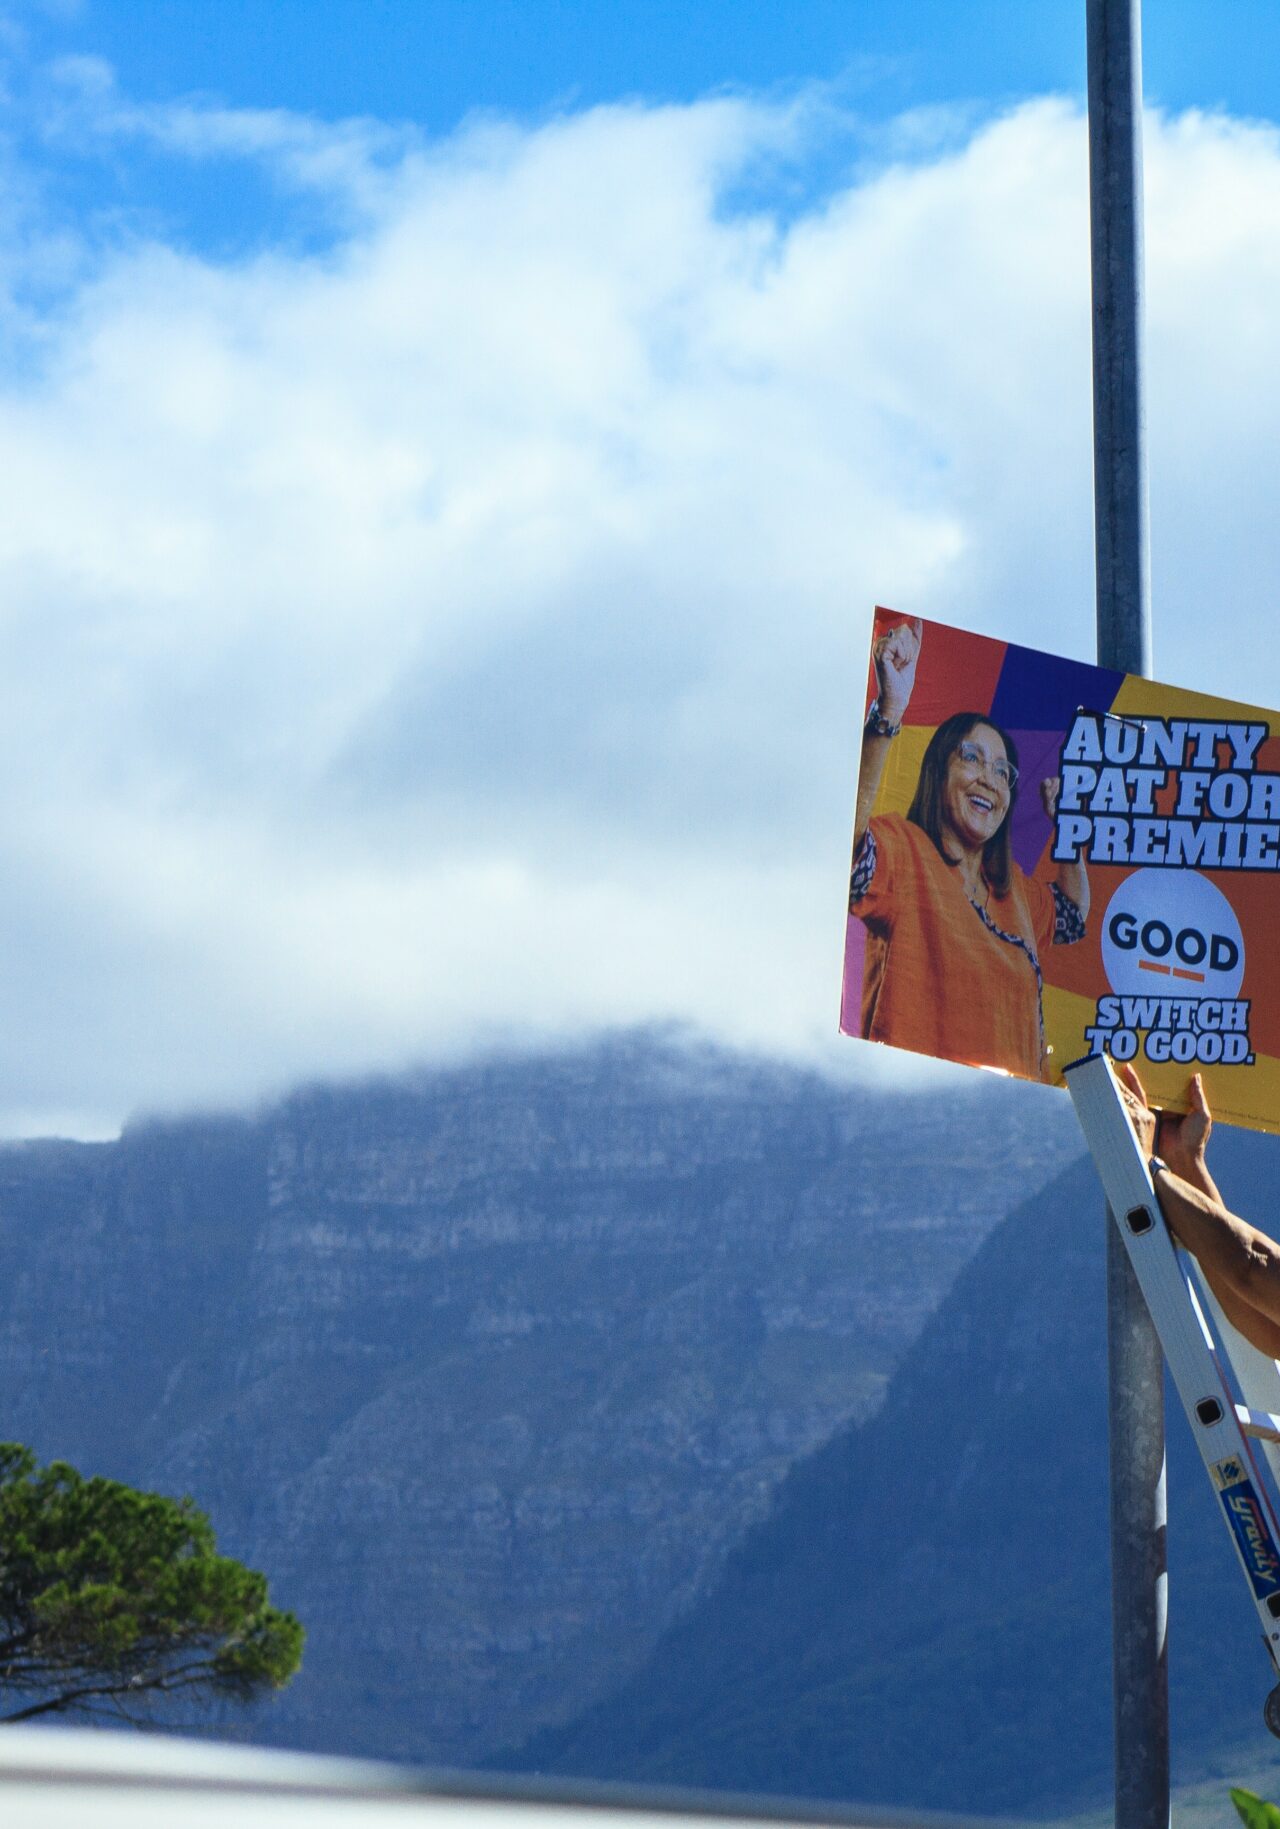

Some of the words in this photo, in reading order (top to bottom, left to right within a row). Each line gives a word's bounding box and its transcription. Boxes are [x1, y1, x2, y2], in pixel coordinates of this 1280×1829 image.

[1063, 715, 1266, 770] AUNTY
[1057, 764, 1166, 814] PAT
[1108, 912, 1239, 972] GOOD
[1097, 995, 1249, 1032] SWITCH
[1085, 1028, 1138, 1061] TO
[1145, 1030, 1255, 1064] GOOD.
